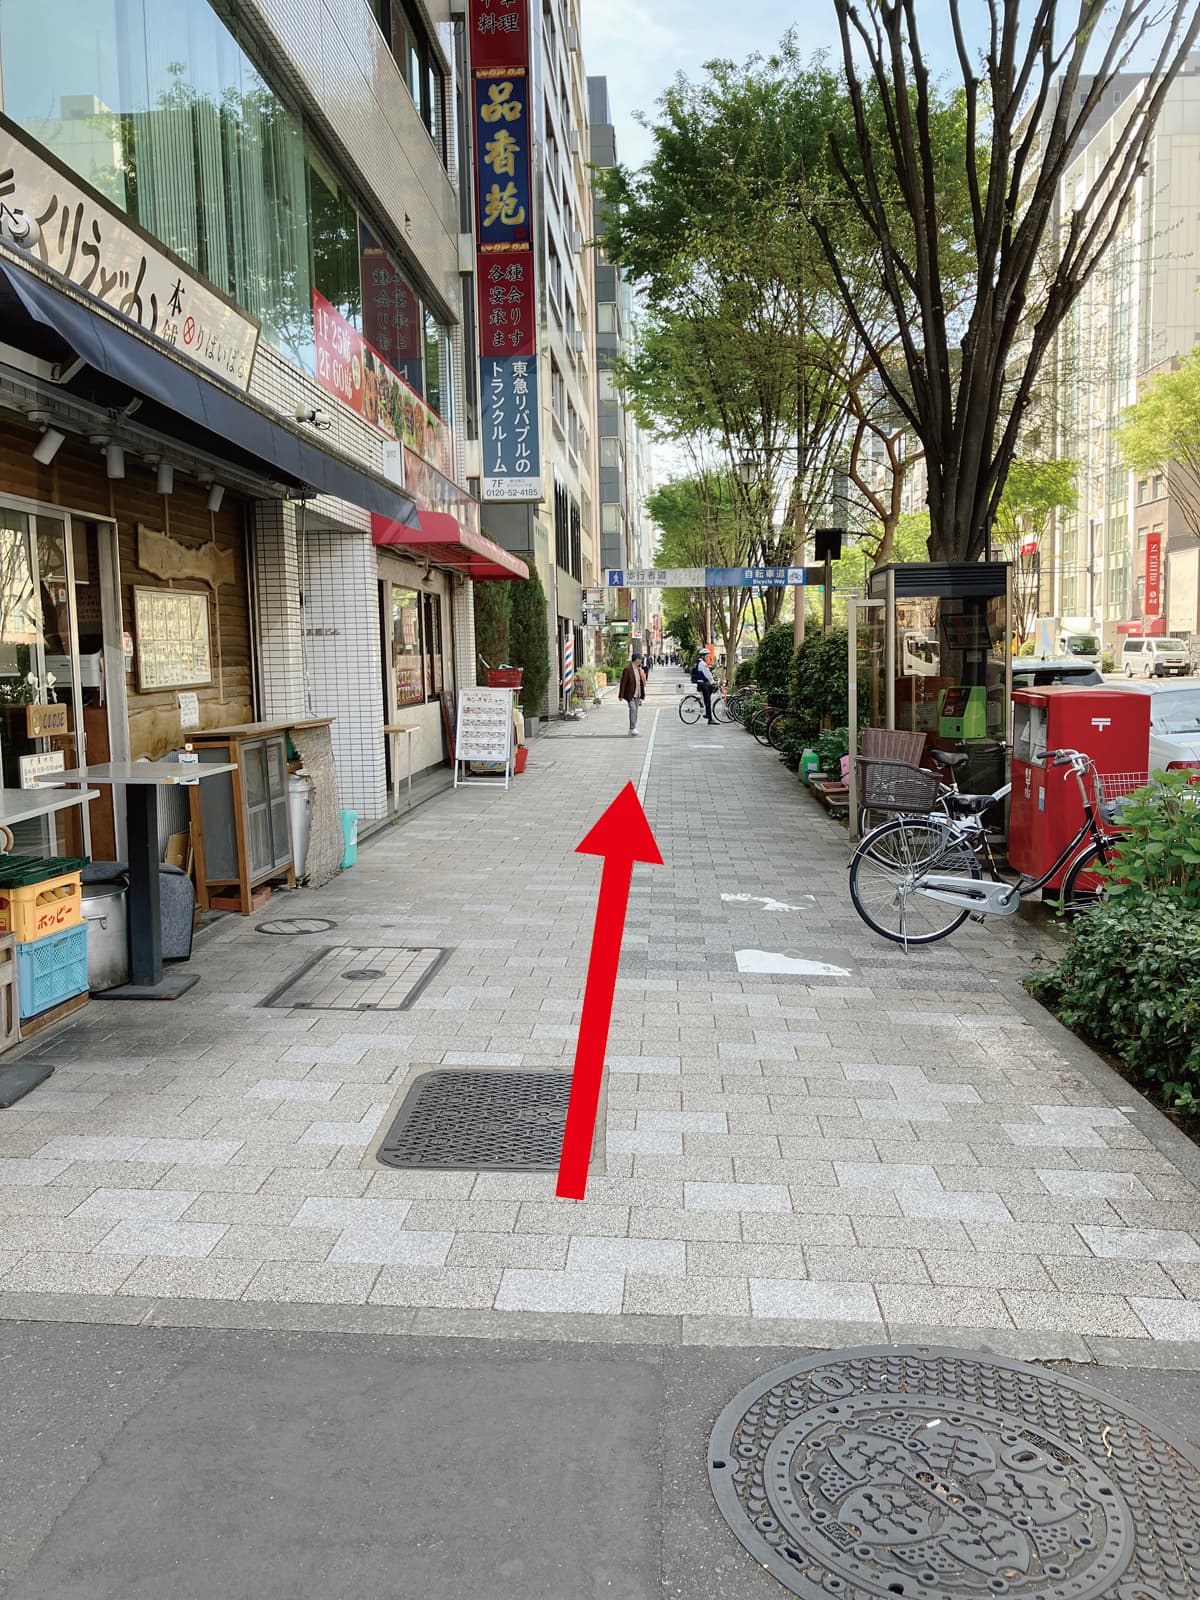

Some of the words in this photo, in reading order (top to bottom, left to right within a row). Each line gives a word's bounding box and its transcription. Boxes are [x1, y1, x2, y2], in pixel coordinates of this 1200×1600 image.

[478, 12, 520, 35] 料理
[481, 82, 525, 227] 品香苑
[488, 263, 524, 283] 各種
[489, 285, 525, 305] 宴会
[489, 307, 522, 326] 承り
[492, 329, 524, 348] ます
[490, 361, 508, 473] トランクルーム
[512, 360, 531, 473] 東急リバブルの
[491, 479, 504, 488] 7F
[626, 570, 667, 580] 歩行者道
[744, 569, 785, 579] 自転車道
[37, 905, 73, 931] ホッピー
